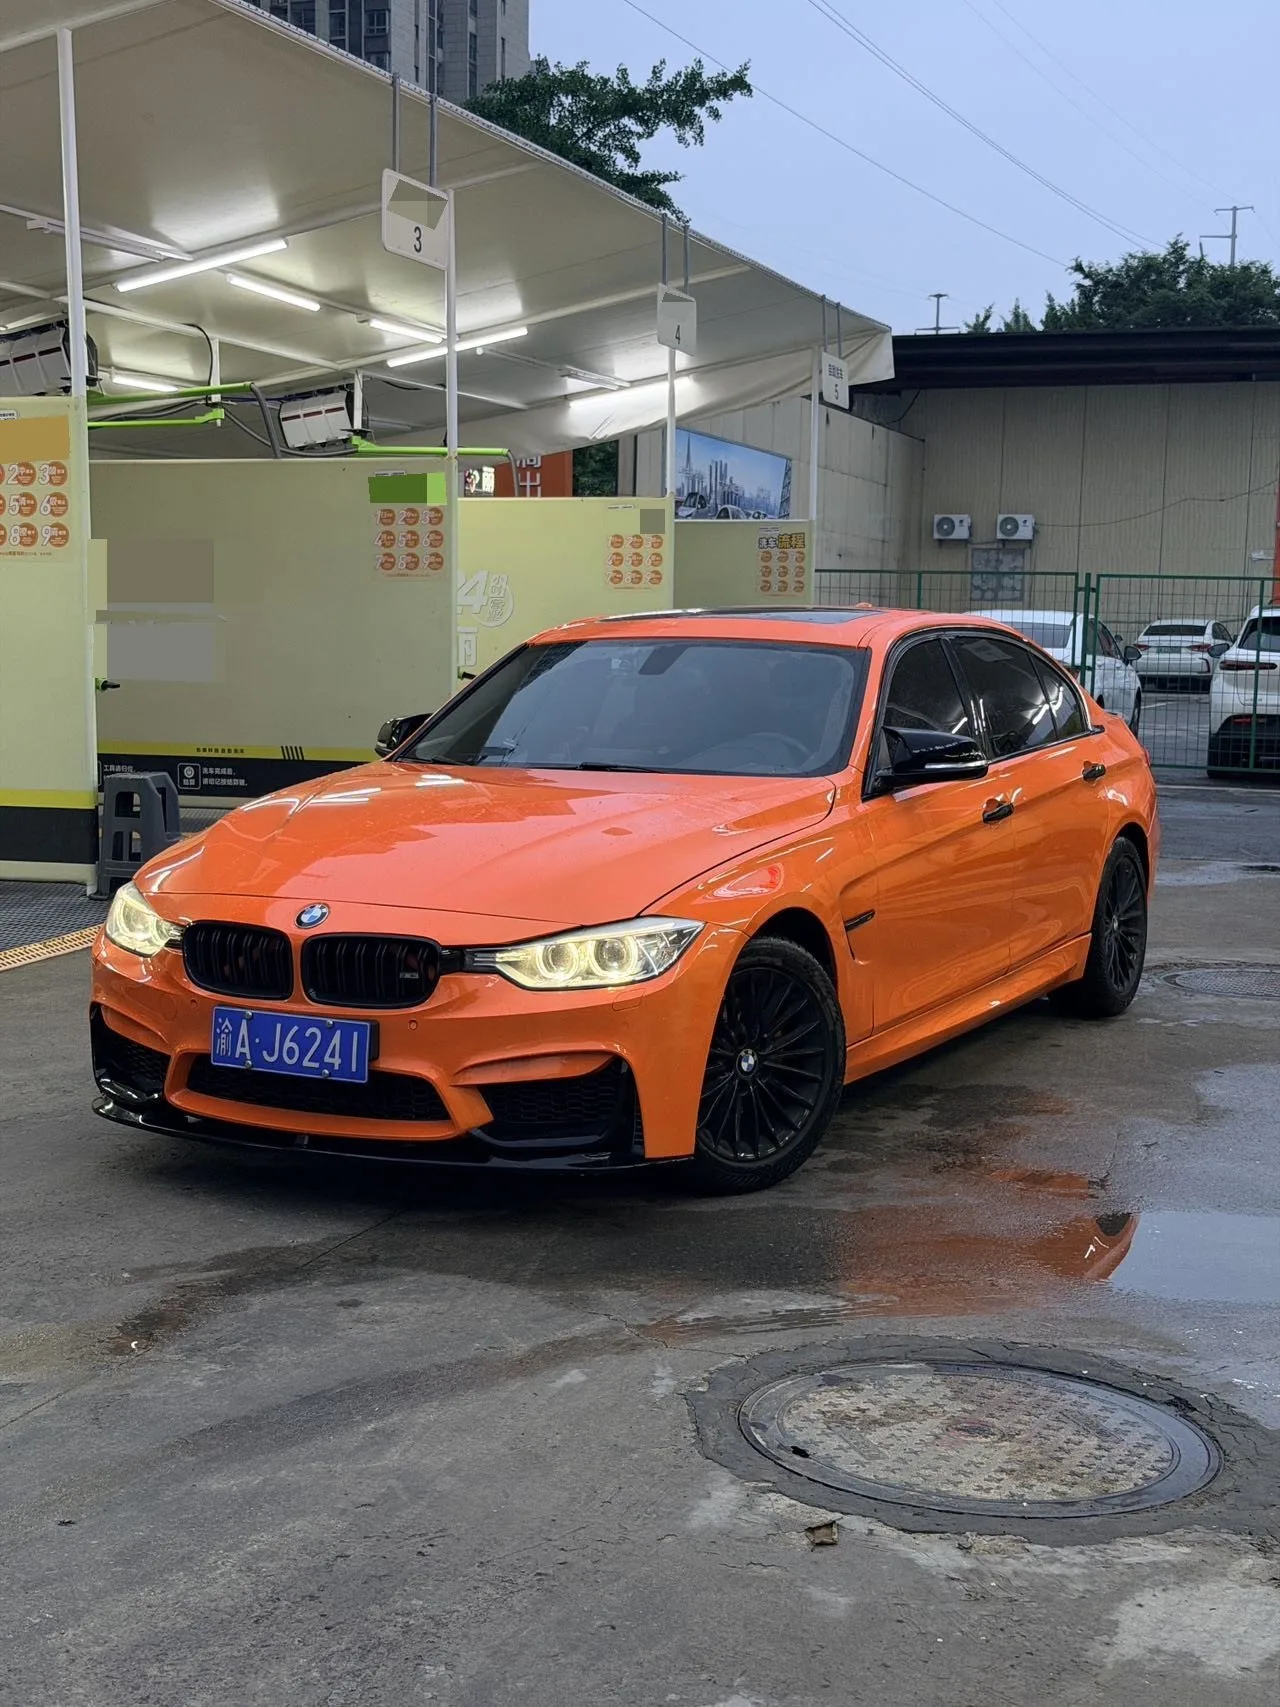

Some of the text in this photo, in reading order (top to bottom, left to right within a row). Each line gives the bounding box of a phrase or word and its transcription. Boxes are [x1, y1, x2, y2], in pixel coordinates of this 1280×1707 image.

[413, 226, 422, 252] 3
[674, 324, 681, 345] 4
[834, 383, 839, 400] 5
[8, 464, 19, 485] 2
[40, 464, 50, 485] 3
[9, 494, 20, 515] 5
[41, 495, 51, 515] 6
[9, 525, 20, 546] 8
[41, 525, 52, 546] 9
[758, 532, 805, 549] 洗车流程
[488, 575, 508, 622] 小时营业
[216, 1017, 358, 1073] 渝A·J6241
